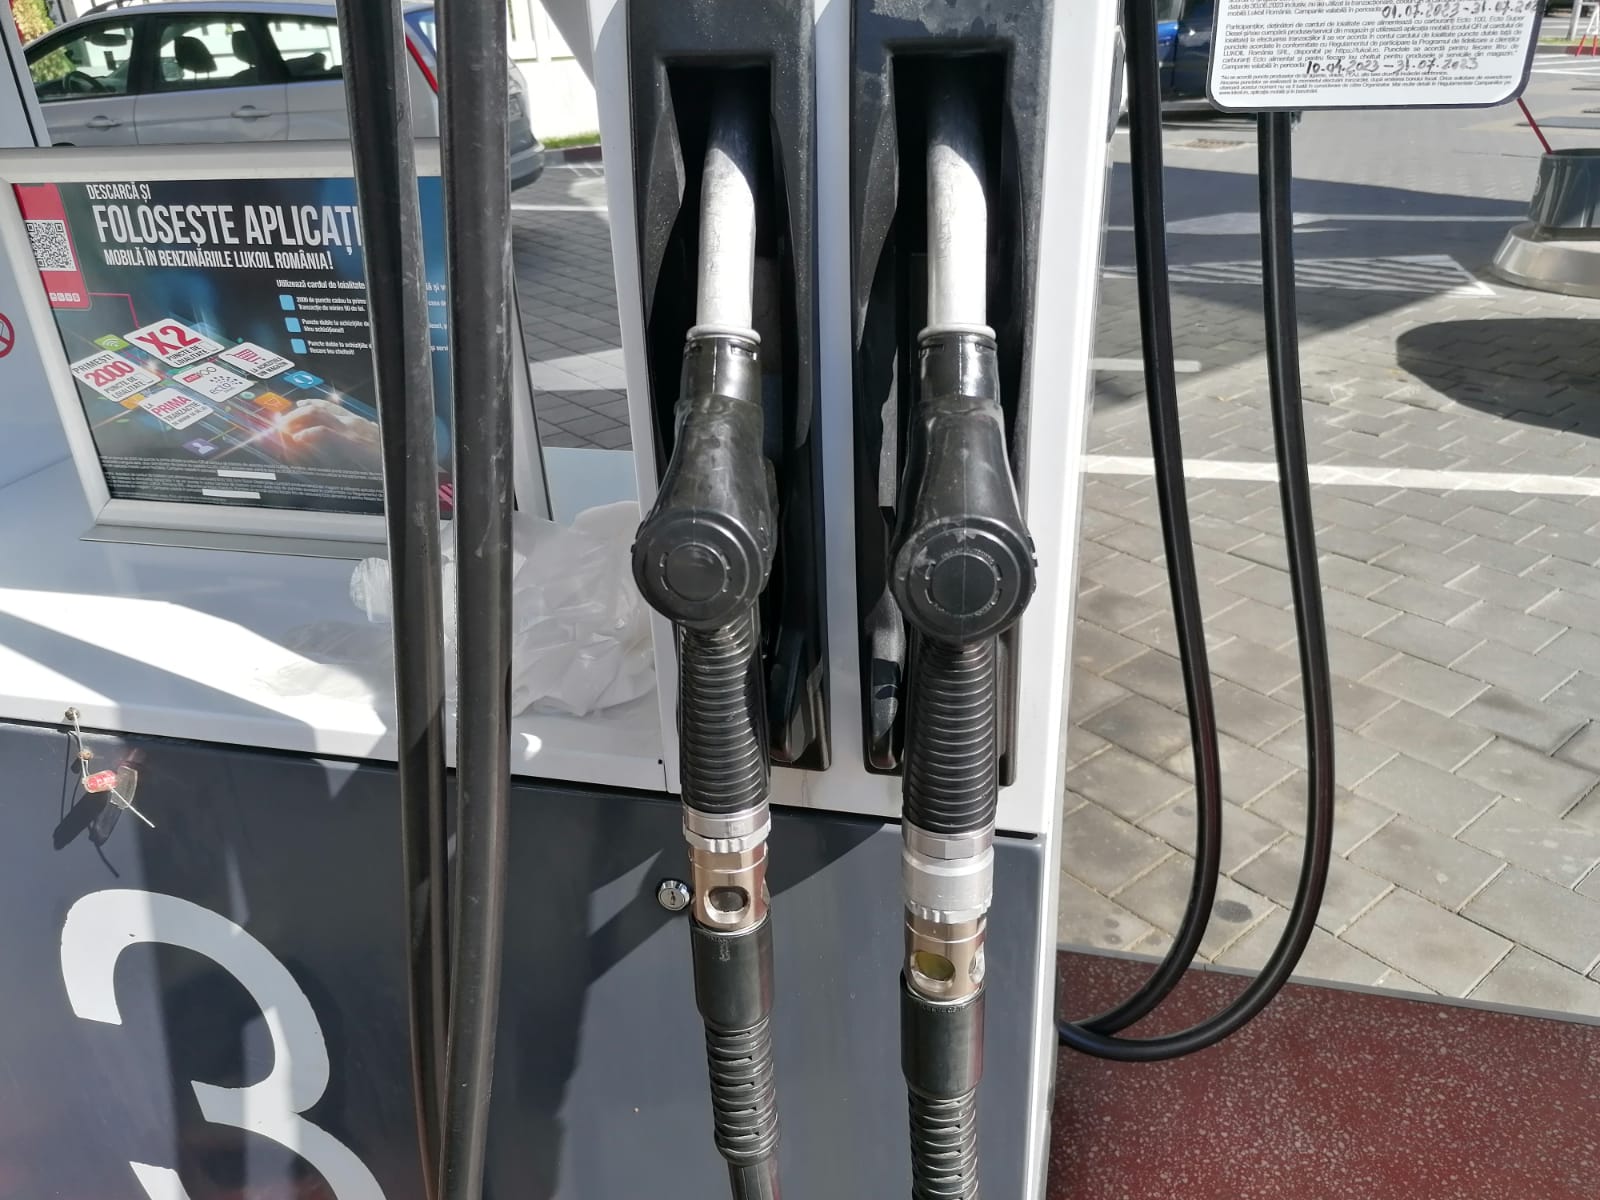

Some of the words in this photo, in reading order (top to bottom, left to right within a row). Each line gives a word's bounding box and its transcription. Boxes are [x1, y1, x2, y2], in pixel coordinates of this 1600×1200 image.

[86, 182, 137, 200] DESCARCĂ
[140, 184, 152, 203] ȘI
[92, 205, 239, 247] FOLOSEȘTE
[245, 205, 362, 255] APLICAȚI
[104, 248, 144, 266] MOBILĂ
[144, 247, 159, 266] ÎN
[160, 248, 232, 268] BENZINĂRIILE
[234, 251, 273, 268] LUKOIL
[275, 250, 334, 270] ROMÂNIA!
[134, 326, 202, 356] X2
[84, 361, 135, 387] 2000
[151, 396, 192, 416] PRIMA
[61, 888, 387, 1200] 3
